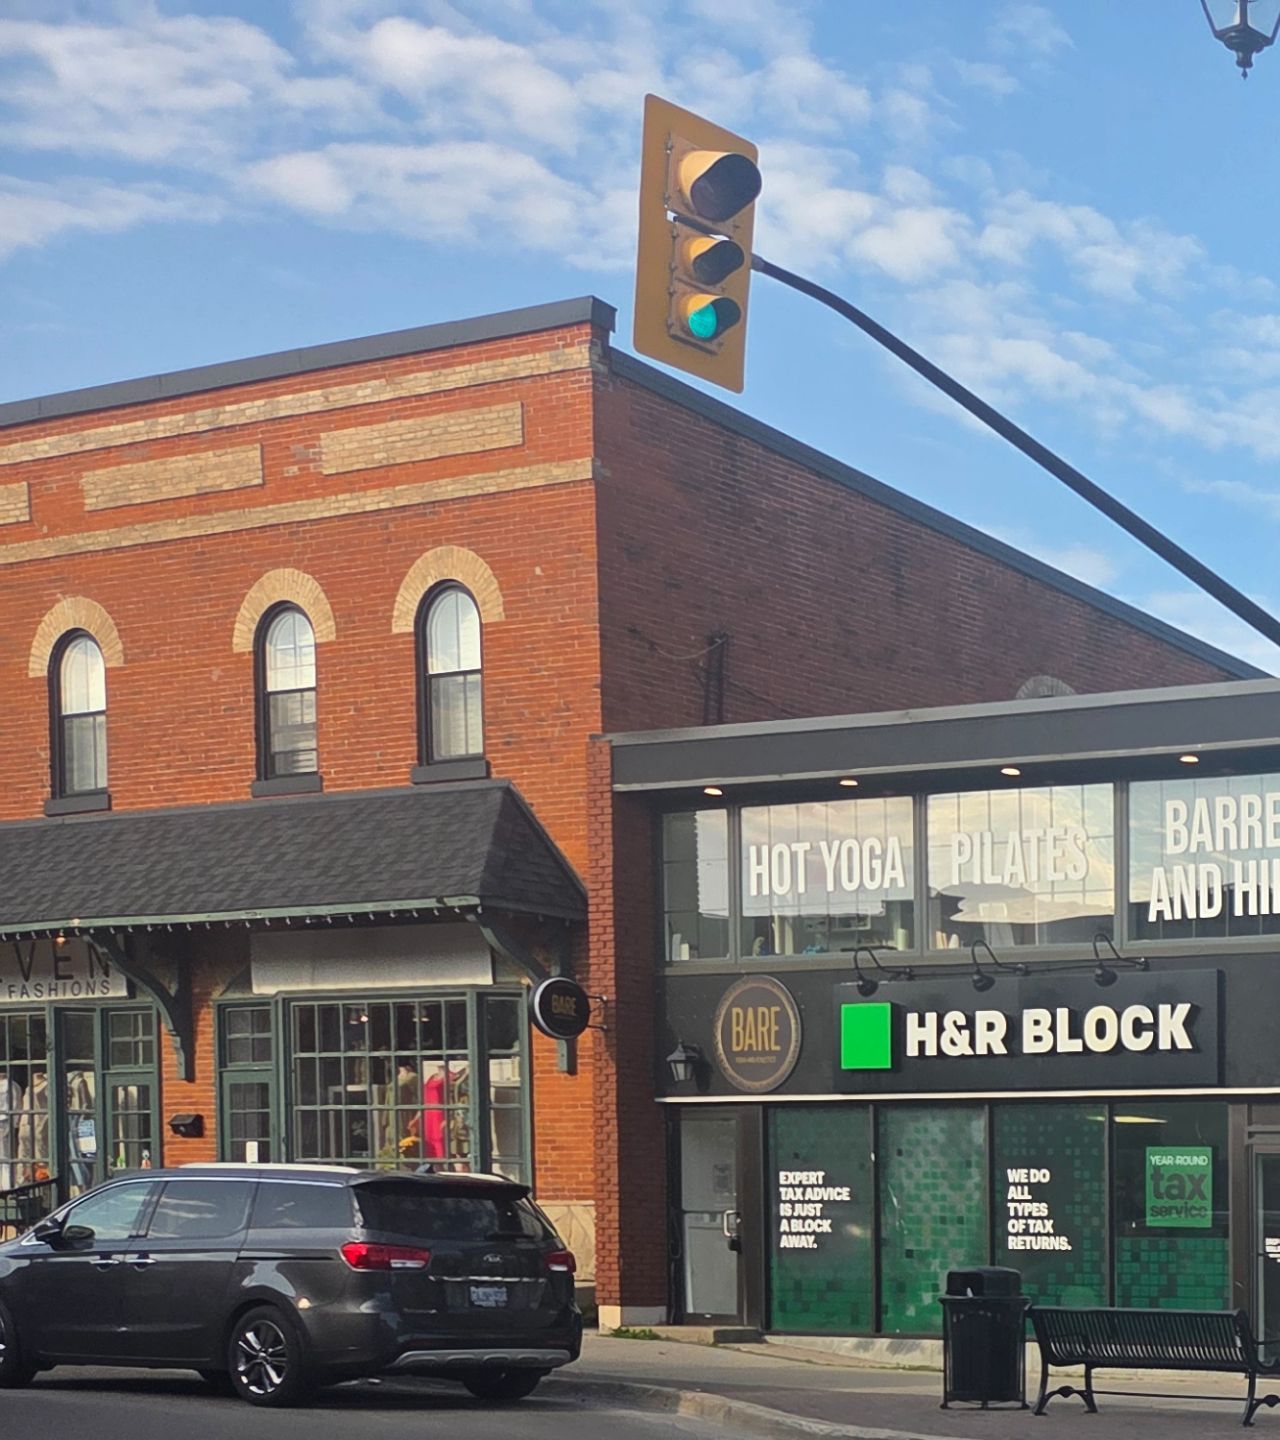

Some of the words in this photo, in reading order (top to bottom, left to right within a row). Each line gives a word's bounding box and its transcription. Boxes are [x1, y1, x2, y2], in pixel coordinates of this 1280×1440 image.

[952, 827, 1089, 886] PILATES
[750, 843, 811, 896] HOT
[819, 837, 906, 892] YOGA
[1148, 863, 1222, 922] AND
[8, 981, 111, 998] FASHIONS
[732, 1006, 781, 1052] BARE
[906, 1010, 1008, 1057] H&R
[1022, 1003, 1193, 1053] BLOCK
[779, 1171, 825, 1185] EXPERT
[1007, 1168, 1028, 1183] WE
[1029, 1168, 1051, 1184] DO
[1151, 1166, 1207, 1201] tax
[779, 1187, 804, 1201] TAX
[804, 1187, 851, 1201] ADVICE
[1007, 1185, 1032, 1200] ALL
[780, 1203, 792, 1217] IS
[793, 1203, 823, 1217] JUST
[1007, 1202, 1048, 1217] TYPES
[1151, 1201, 1207, 1218] service
[780, 1218, 790, 1233] A
[790, 1218, 832, 1233] BLOCK
[1007, 1219, 1026, 1234] OF
[1027, 1219, 1054, 1234] TAX
[780, 1234, 818, 1249] AWAY.
[1008, 1235, 1072, 1250] RETURNS.
